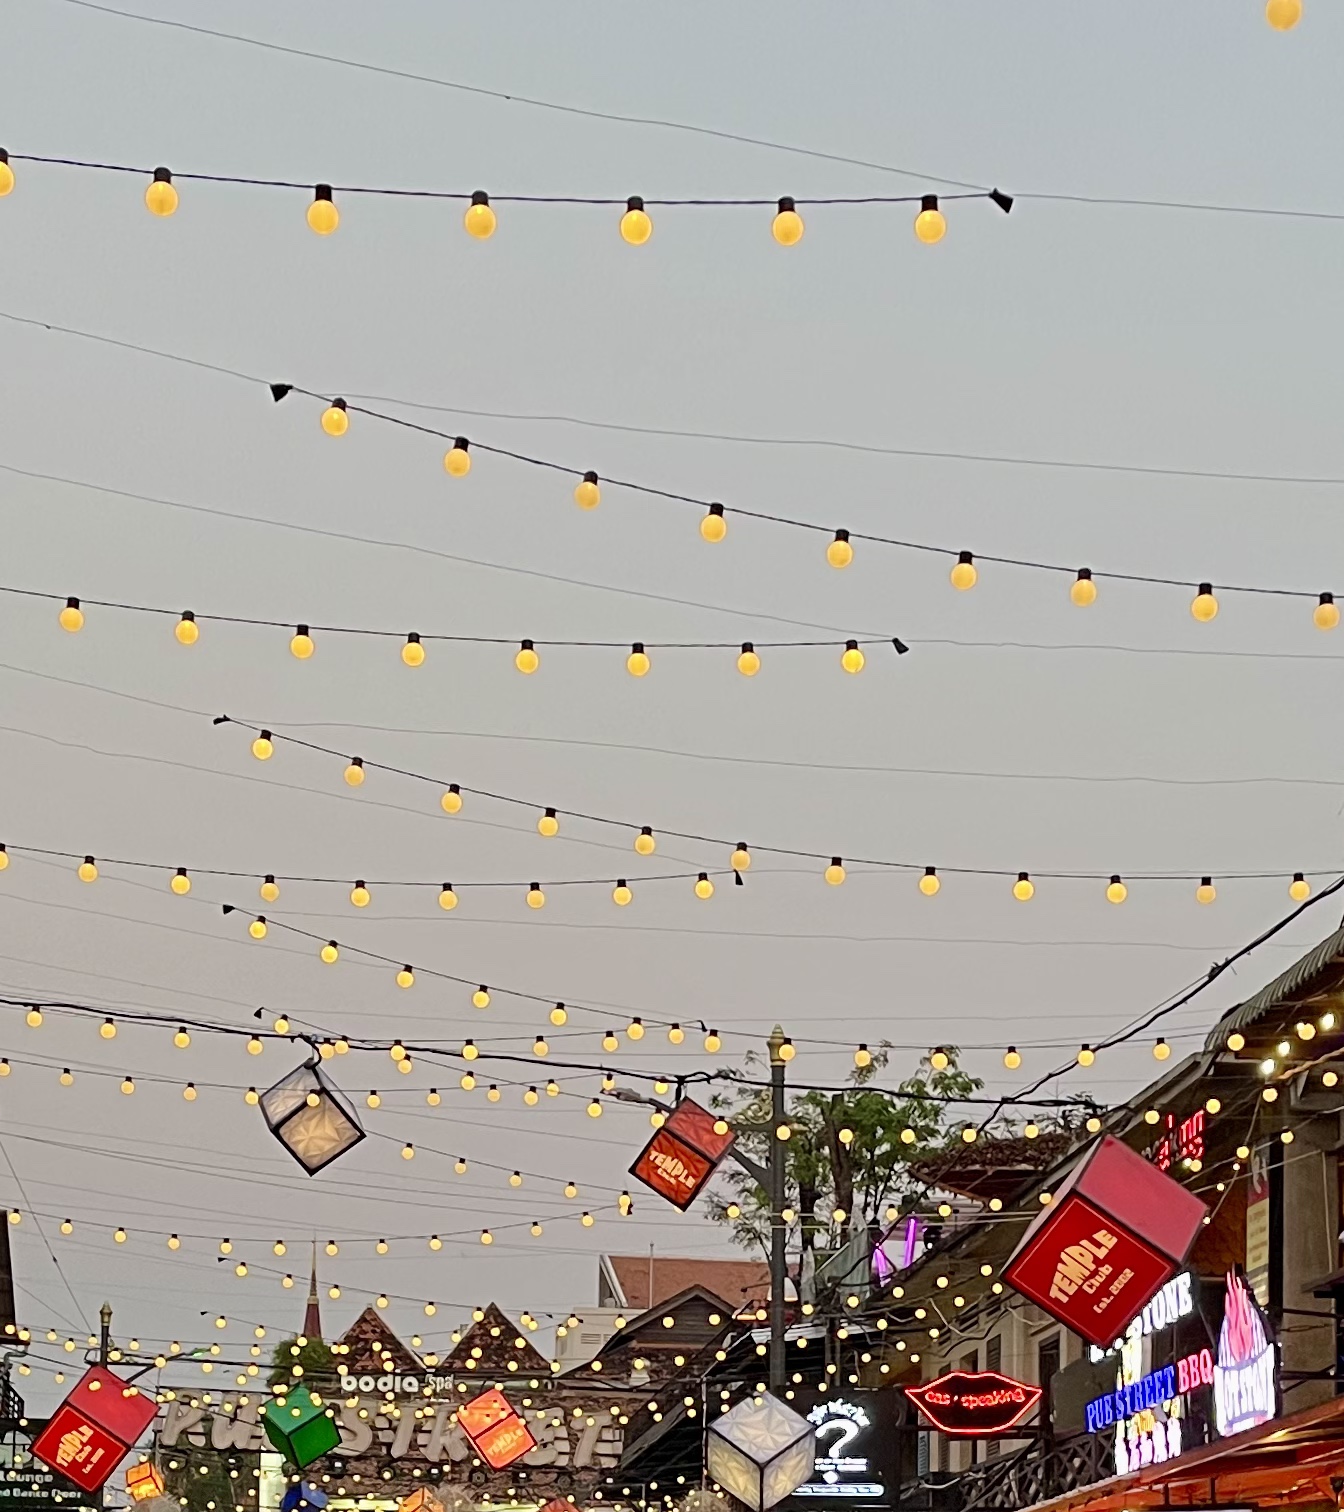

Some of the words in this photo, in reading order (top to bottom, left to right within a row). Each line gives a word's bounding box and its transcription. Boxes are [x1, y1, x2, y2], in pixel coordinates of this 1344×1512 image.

[649, 1150, 696, 1189] TEMPLE
[1049, 1229, 1119, 1305] TEMPLE
[1082, 1264, 1113, 1295] Club
[340, 1373, 419, 1393] bodia
[961, 1387, 1027, 1410] speaking
[1086, 1393, 1114, 1434] PUB
[1116, 1366, 1175, 1419] STREET
[1177, 1348, 1214, 1394] BBQ
[56, 1424, 95, 1468] TEMPLE
[159, 1391, 258, 1450] PU
[335, 1400, 624, 1468] STRET
[0, 1470, 54, 1483] Lounge
[12, 1488, 49, 1498] Dance
